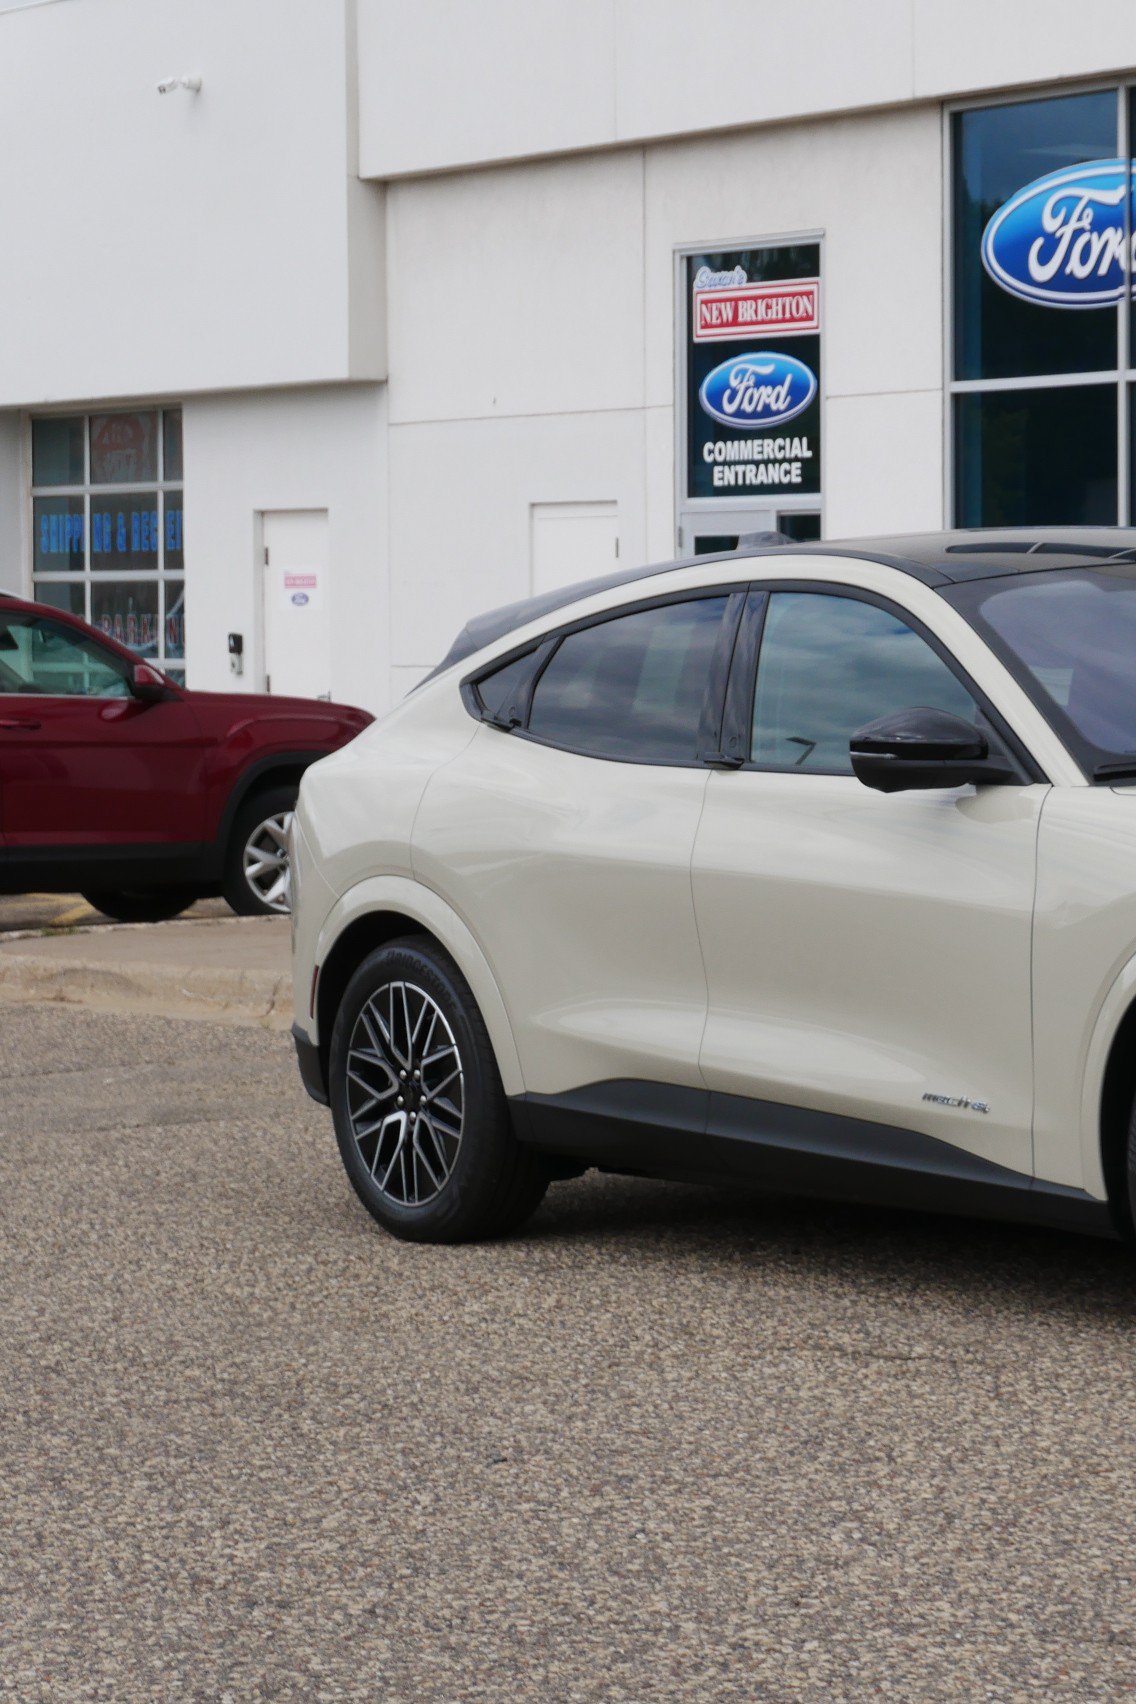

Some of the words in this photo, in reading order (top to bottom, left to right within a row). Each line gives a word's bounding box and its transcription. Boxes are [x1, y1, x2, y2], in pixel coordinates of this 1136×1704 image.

[701, 301, 735, 326] NEW
[738, 295, 813, 322] BRIGHTON
[722, 362, 793, 415] Ford
[703, 437, 812, 463] COMMERCIAL
[713, 462, 802, 487] ENTRANCE
